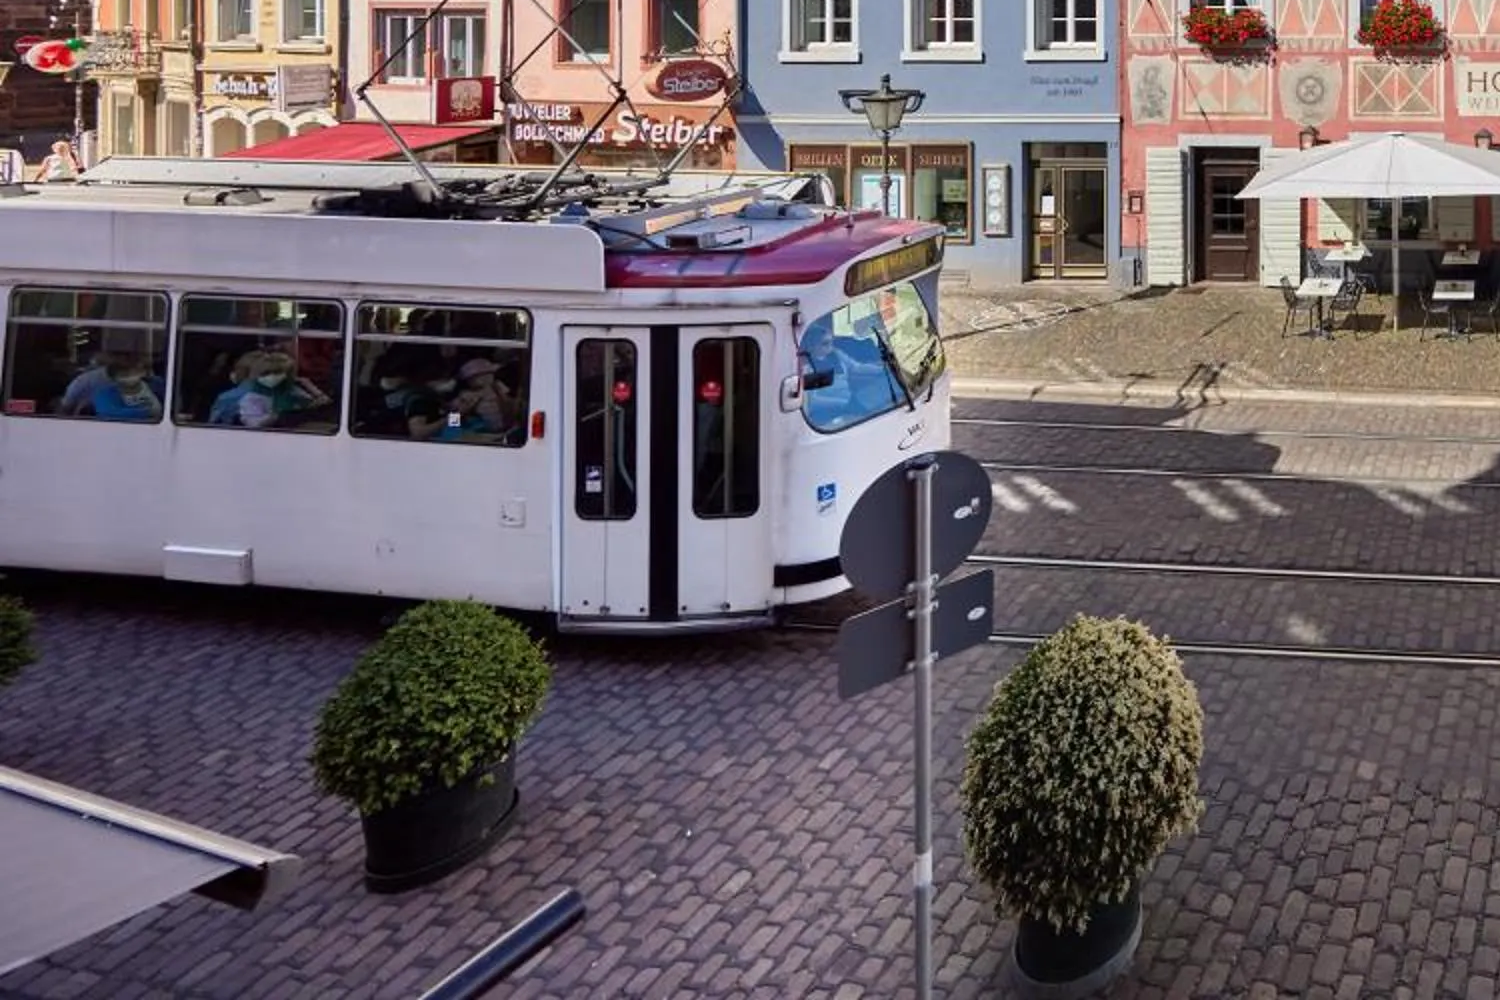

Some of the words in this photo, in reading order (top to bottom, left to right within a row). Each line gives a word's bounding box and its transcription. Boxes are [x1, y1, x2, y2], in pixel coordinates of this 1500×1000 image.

[663, 76, 723, 95] Steiber
[612, 109, 723, 145] Steiber
[861, 153, 897, 167] OPTK
